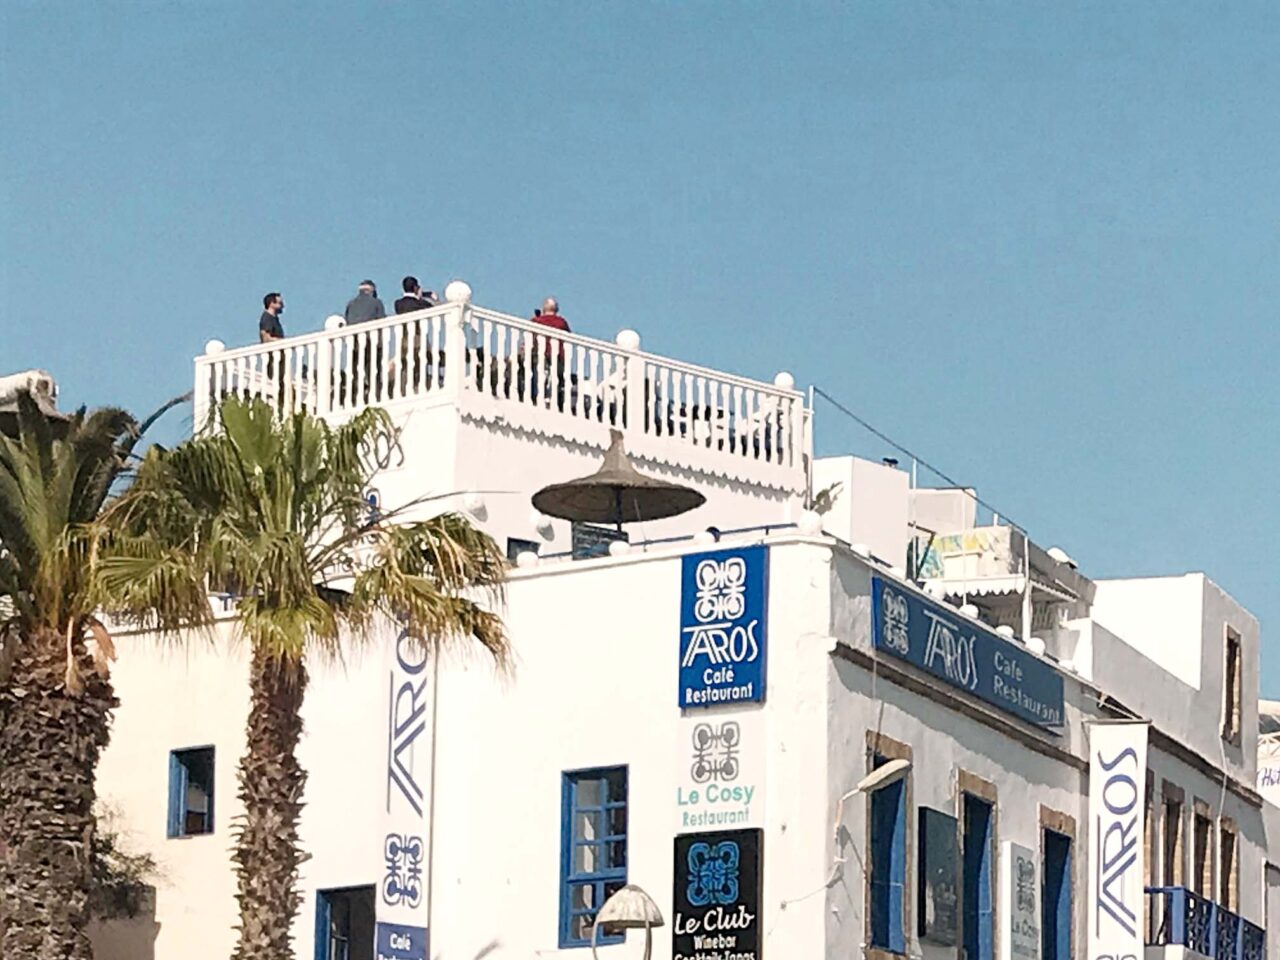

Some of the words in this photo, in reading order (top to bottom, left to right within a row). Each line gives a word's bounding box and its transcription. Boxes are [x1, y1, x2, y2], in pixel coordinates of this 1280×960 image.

[682, 619, 758, 668] TAROS
[923, 609, 979, 691] TAROS
[703, 664, 735, 685] Café
[685, 682, 753, 704] Restaurant
[994, 675, 1061, 724] Restaurant
[386, 612, 428, 818] TARO
[677, 786, 700, 806] Le
[706, 784, 755, 804] Cosy
[683, 807, 750, 827] Restaurant
[1096, 747, 1138, 939] TAROS
[674, 912, 701, 935] Le
[703, 905, 755, 931] Club
[694, 933, 736, 951] Winebar
